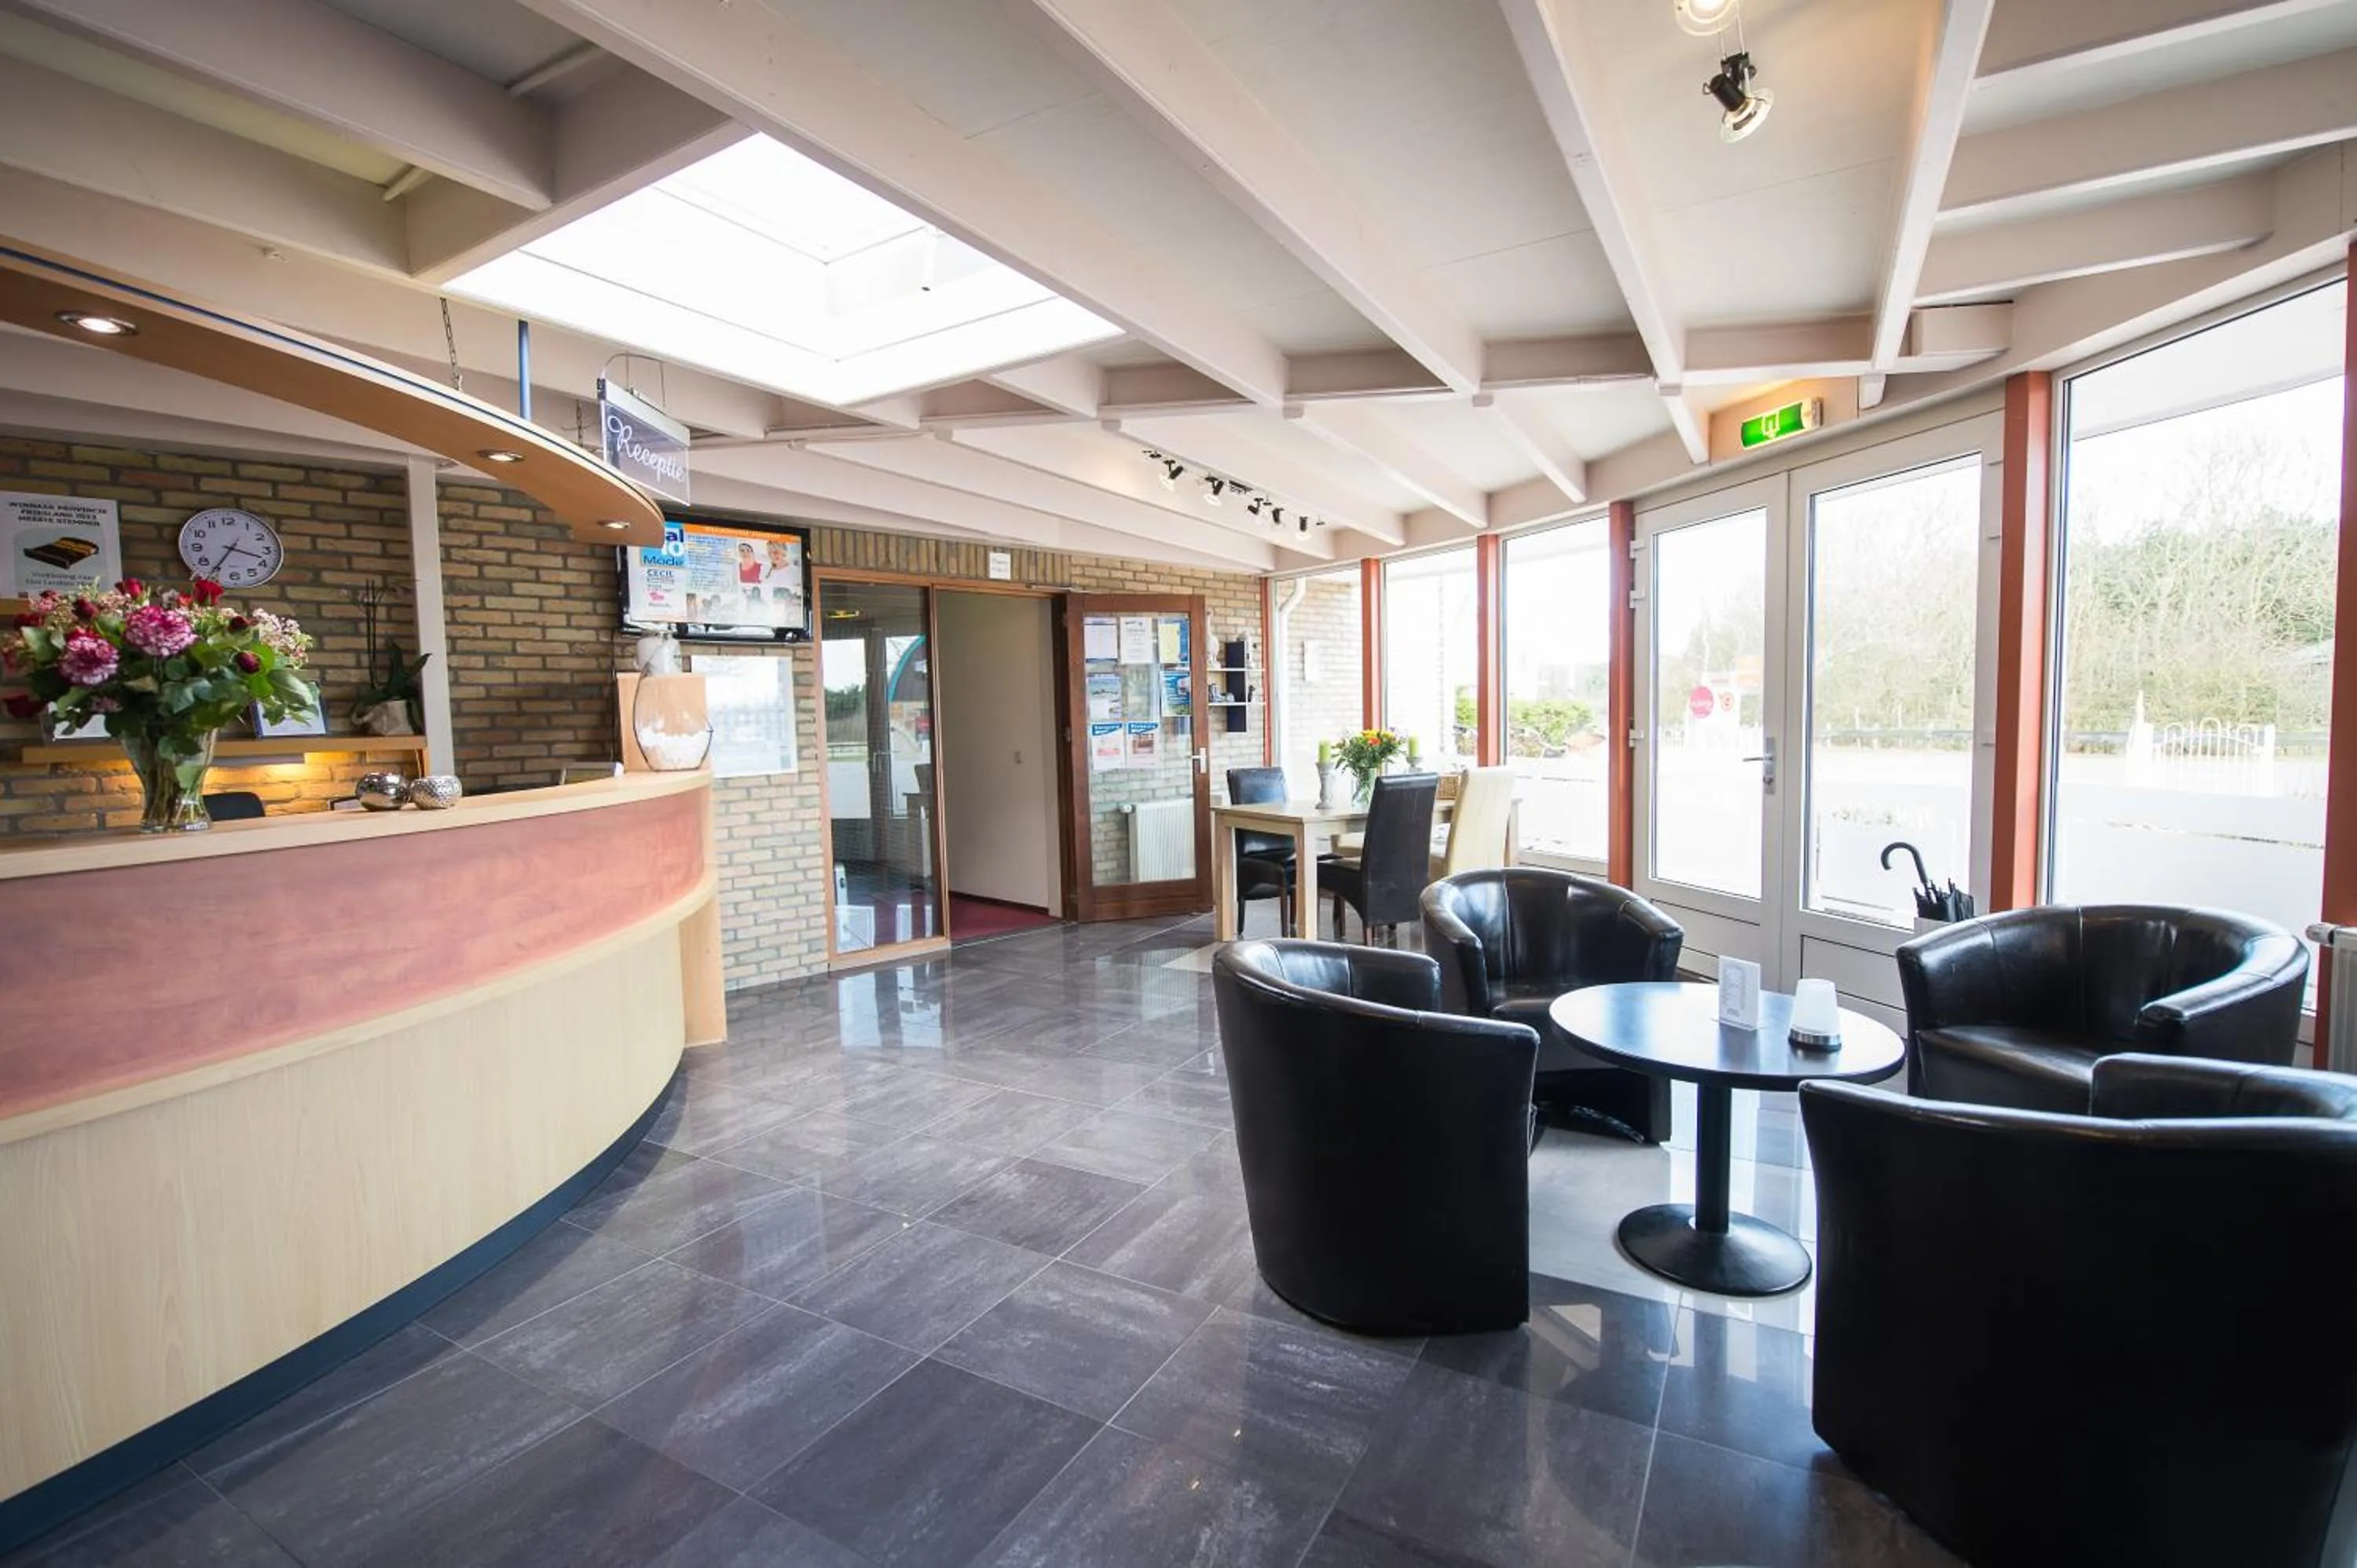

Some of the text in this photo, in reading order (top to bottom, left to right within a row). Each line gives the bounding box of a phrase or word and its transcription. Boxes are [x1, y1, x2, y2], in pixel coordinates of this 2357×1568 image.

[607, 416, 686, 483] Receptie
[208, 520, 216, 529] 11
[222, 517, 235, 526] 12
[246, 522, 249, 531] 1
[194, 529, 206, 538] 10
[255, 533, 265, 541] 2
[191, 543, 203, 552] 9
[262, 546, 272, 555] 3
[198, 557, 210, 566] 8
[258, 559, 268, 568] 4
[229, 572, 240, 581] 6
[247, 568, 258, 577] 5
